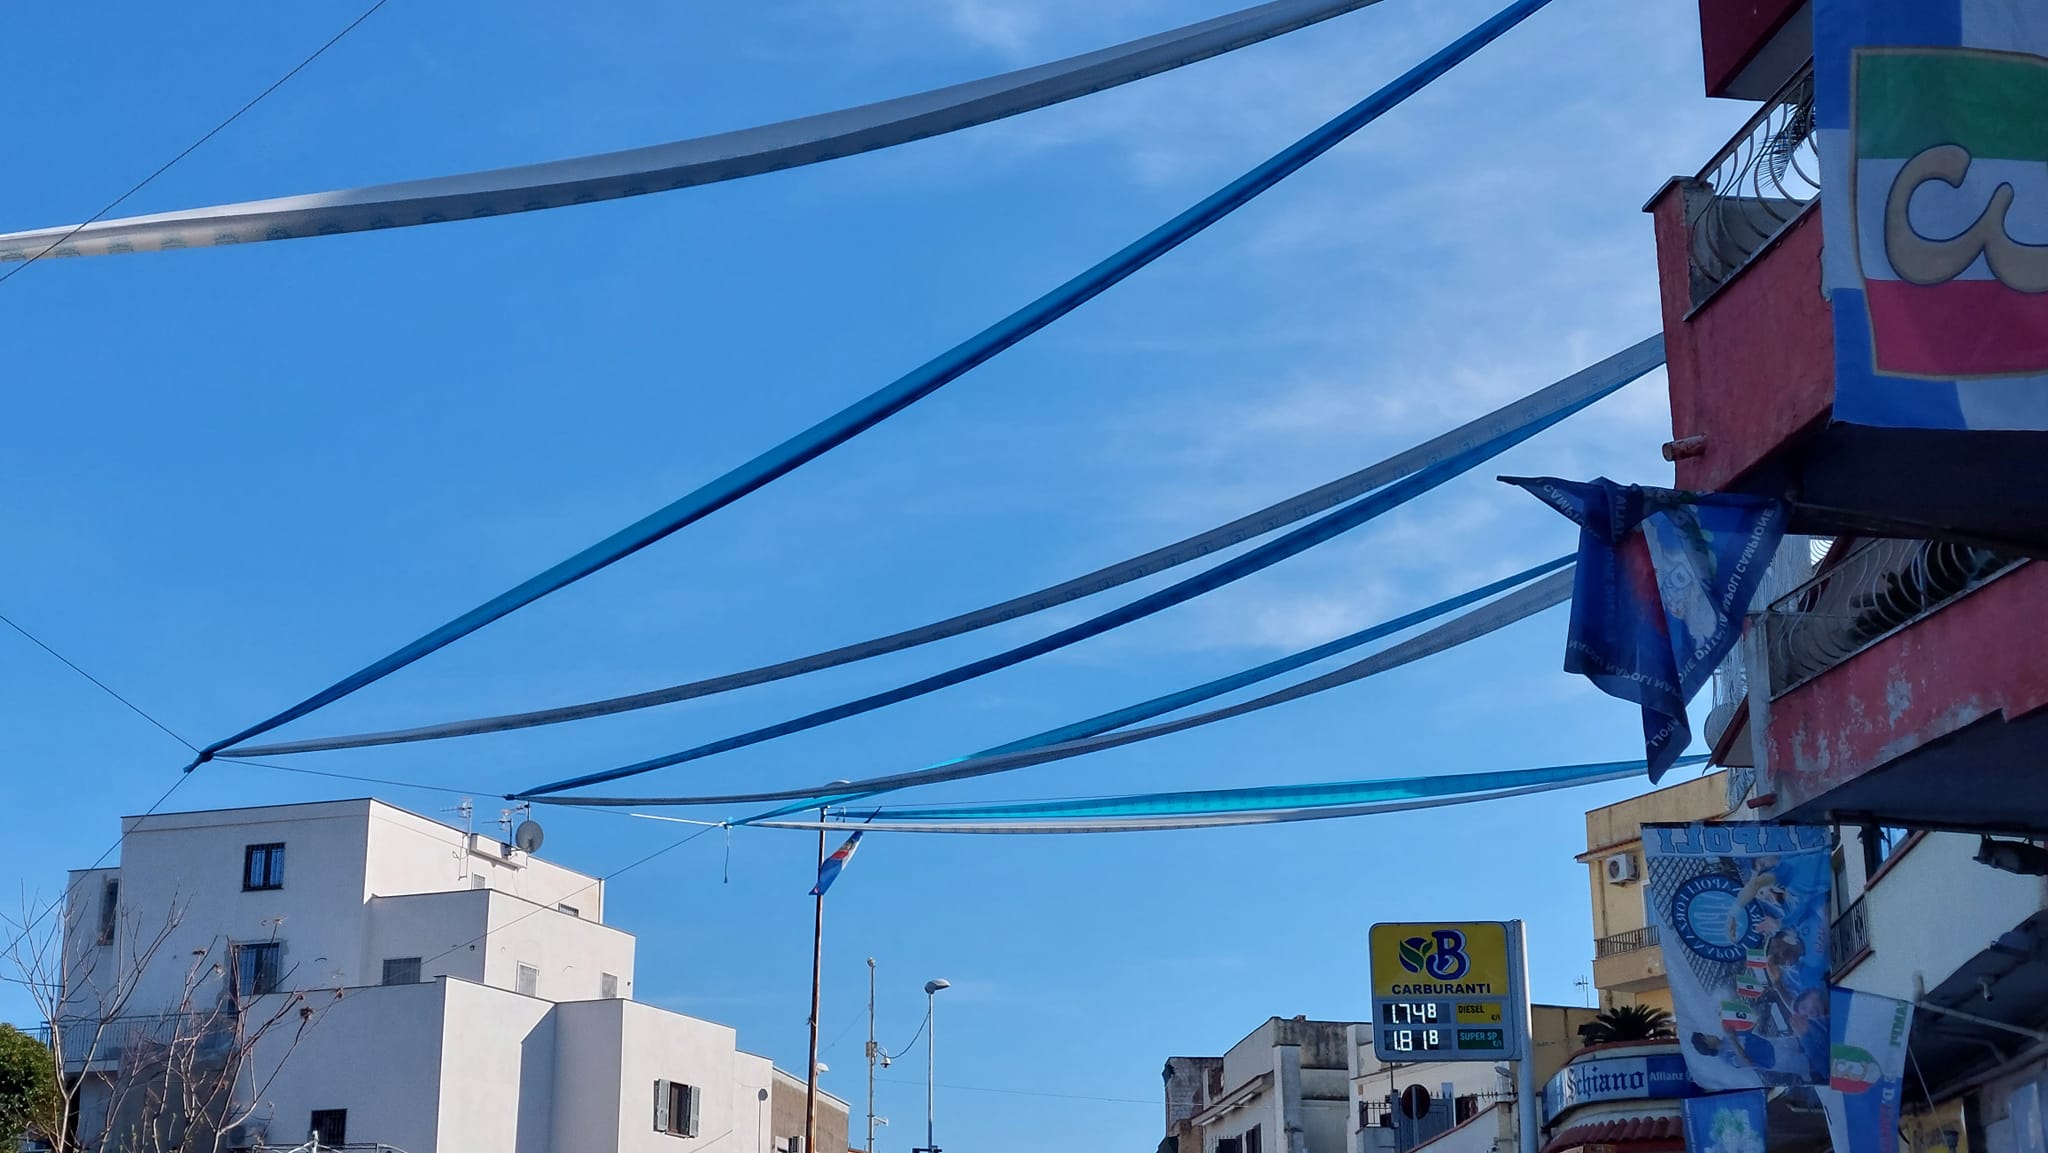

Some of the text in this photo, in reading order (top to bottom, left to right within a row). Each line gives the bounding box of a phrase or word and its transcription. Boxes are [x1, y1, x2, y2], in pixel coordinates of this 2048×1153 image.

[1391, 983, 1492, 996] CARBURANTI
[1391, 1003, 1437, 1024] 1.748
[1457, 1005, 1485, 1014] DIESEL
[1393, 1029, 1440, 1052] 1.818
[1459, 1031, 1498, 1042] SUPER SP
[1566, 1064, 1684, 1100] Schiano Allianz
